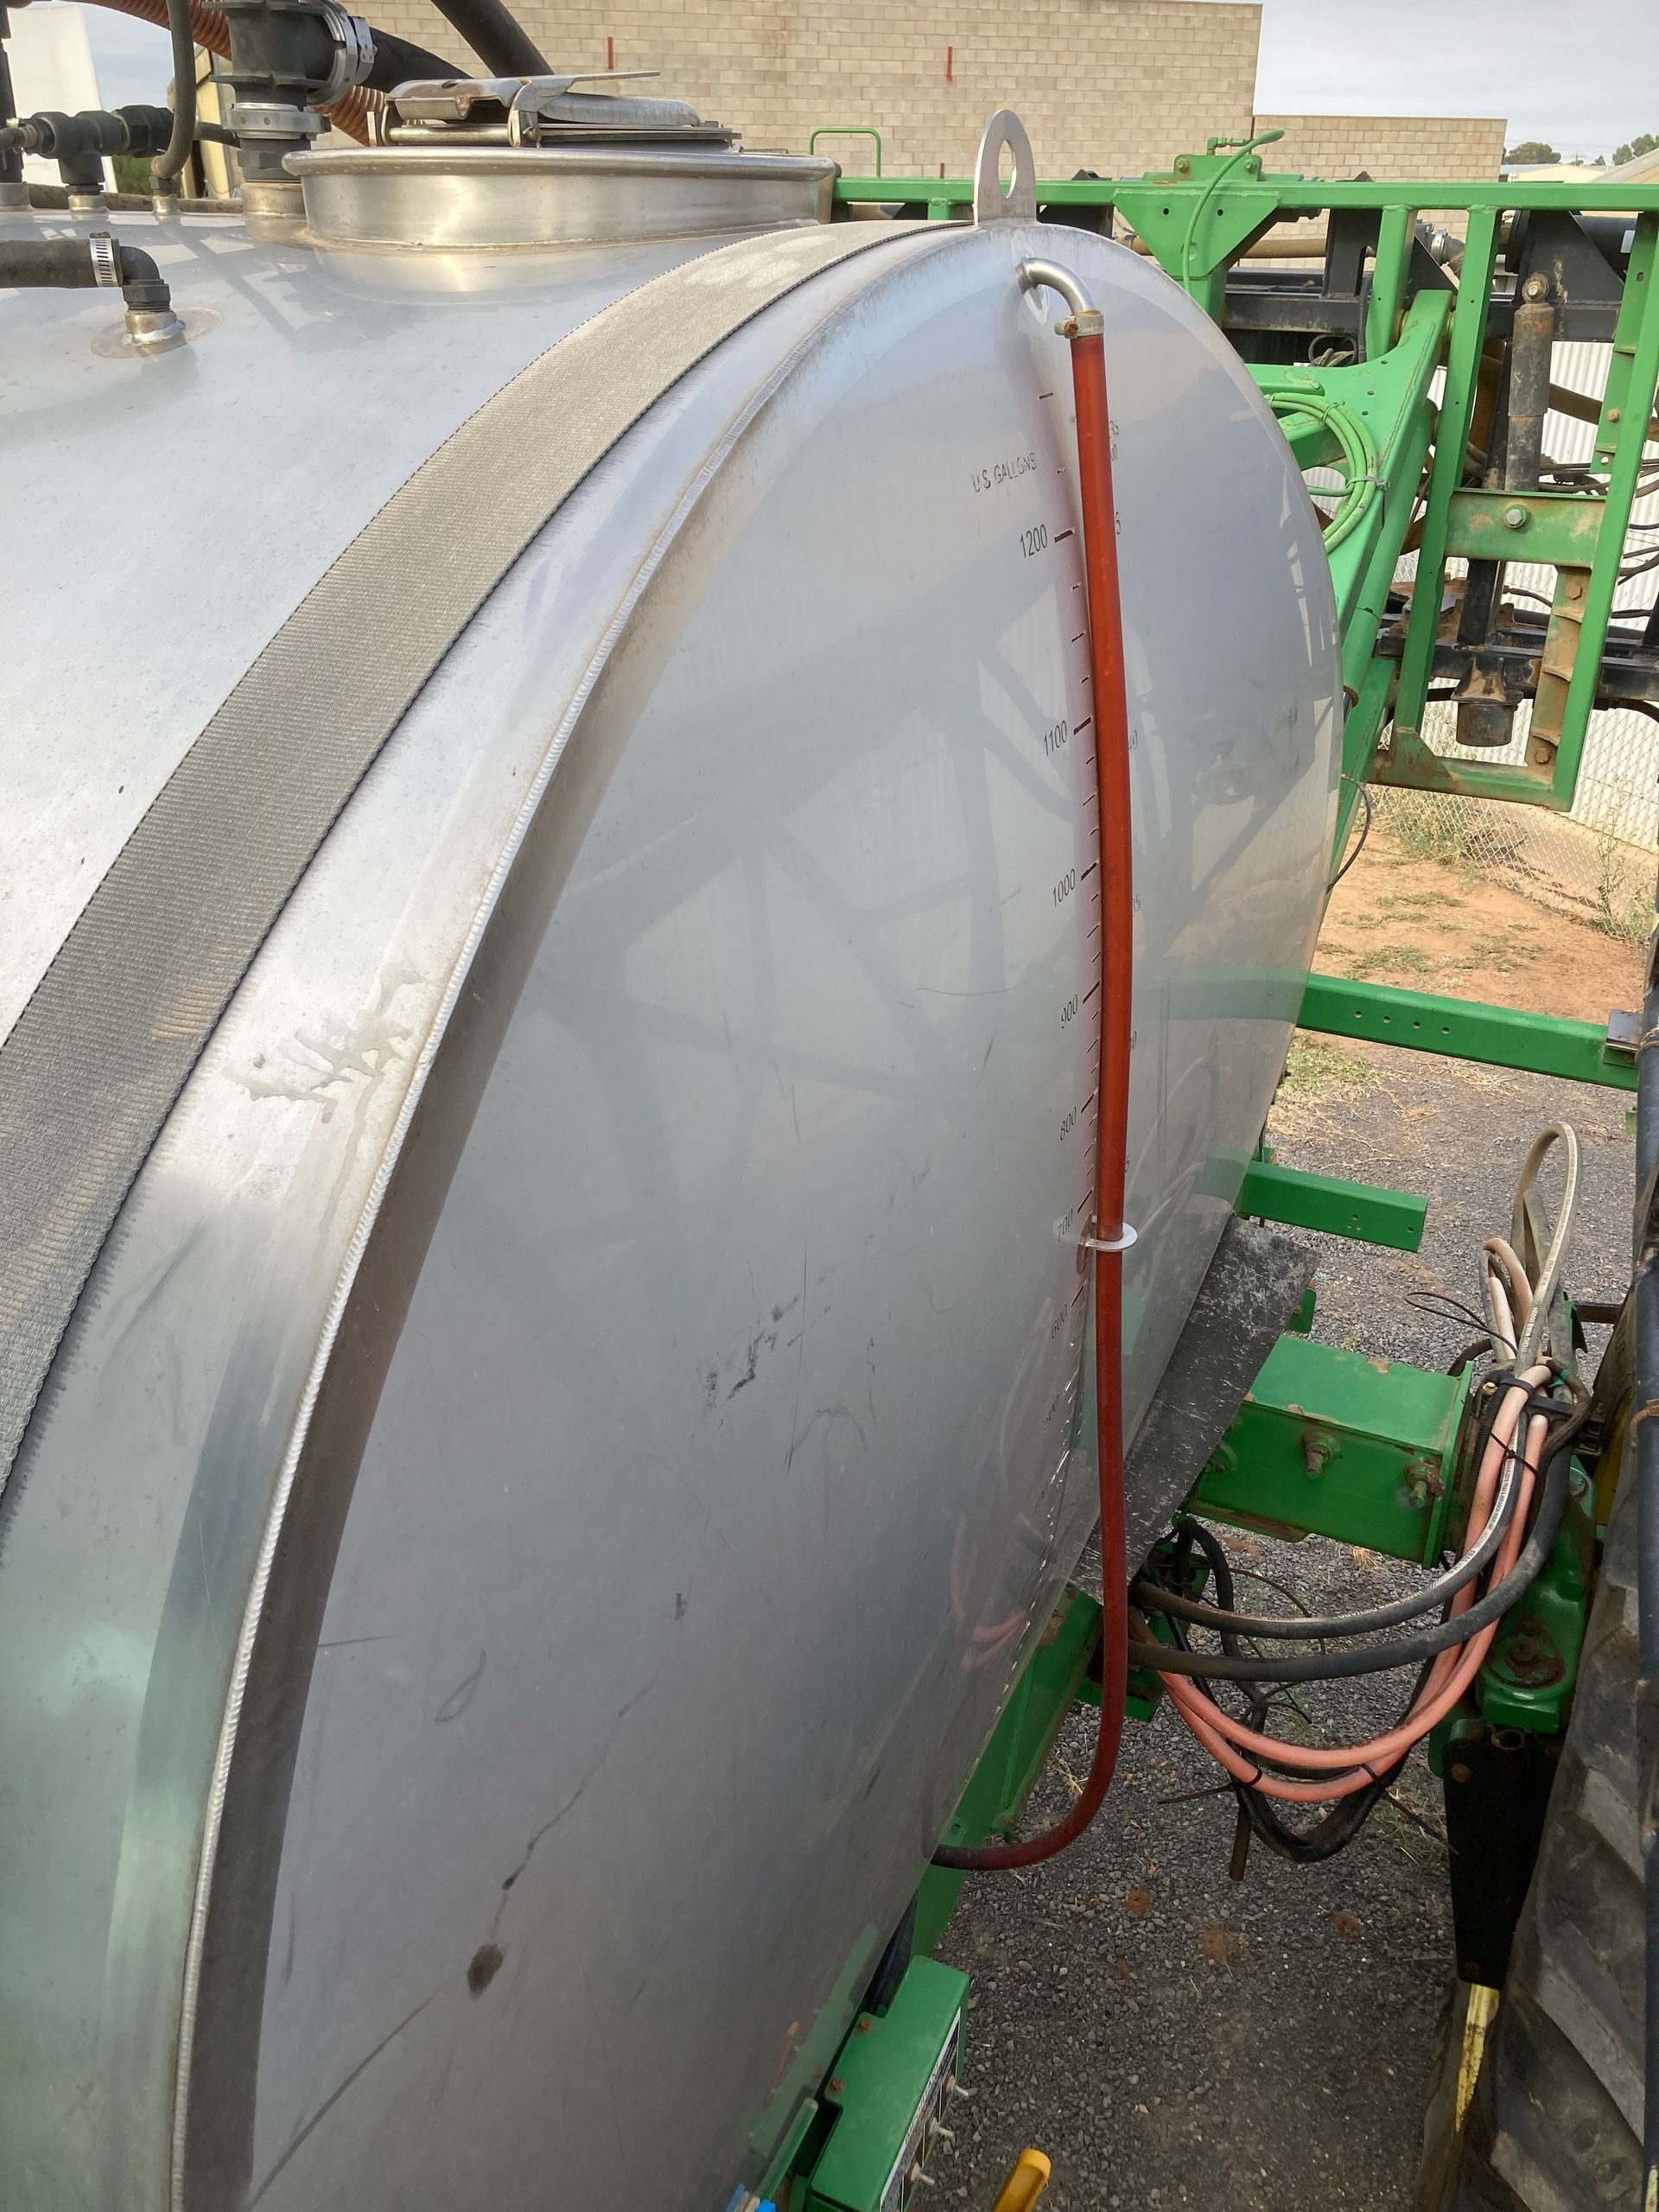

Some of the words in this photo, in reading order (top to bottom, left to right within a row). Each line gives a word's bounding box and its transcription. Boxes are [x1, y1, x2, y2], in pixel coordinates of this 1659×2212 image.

[995, 452, 1037, 485] GALLONS
[1020, 524, 1048, 558] 1200
[1044, 720, 1067, 756] 1100
[1052, 868, 1076, 907] 1000
[1061, 994, 1078, 1029] 900
[1060, 1106, 1077, 1141] 800
